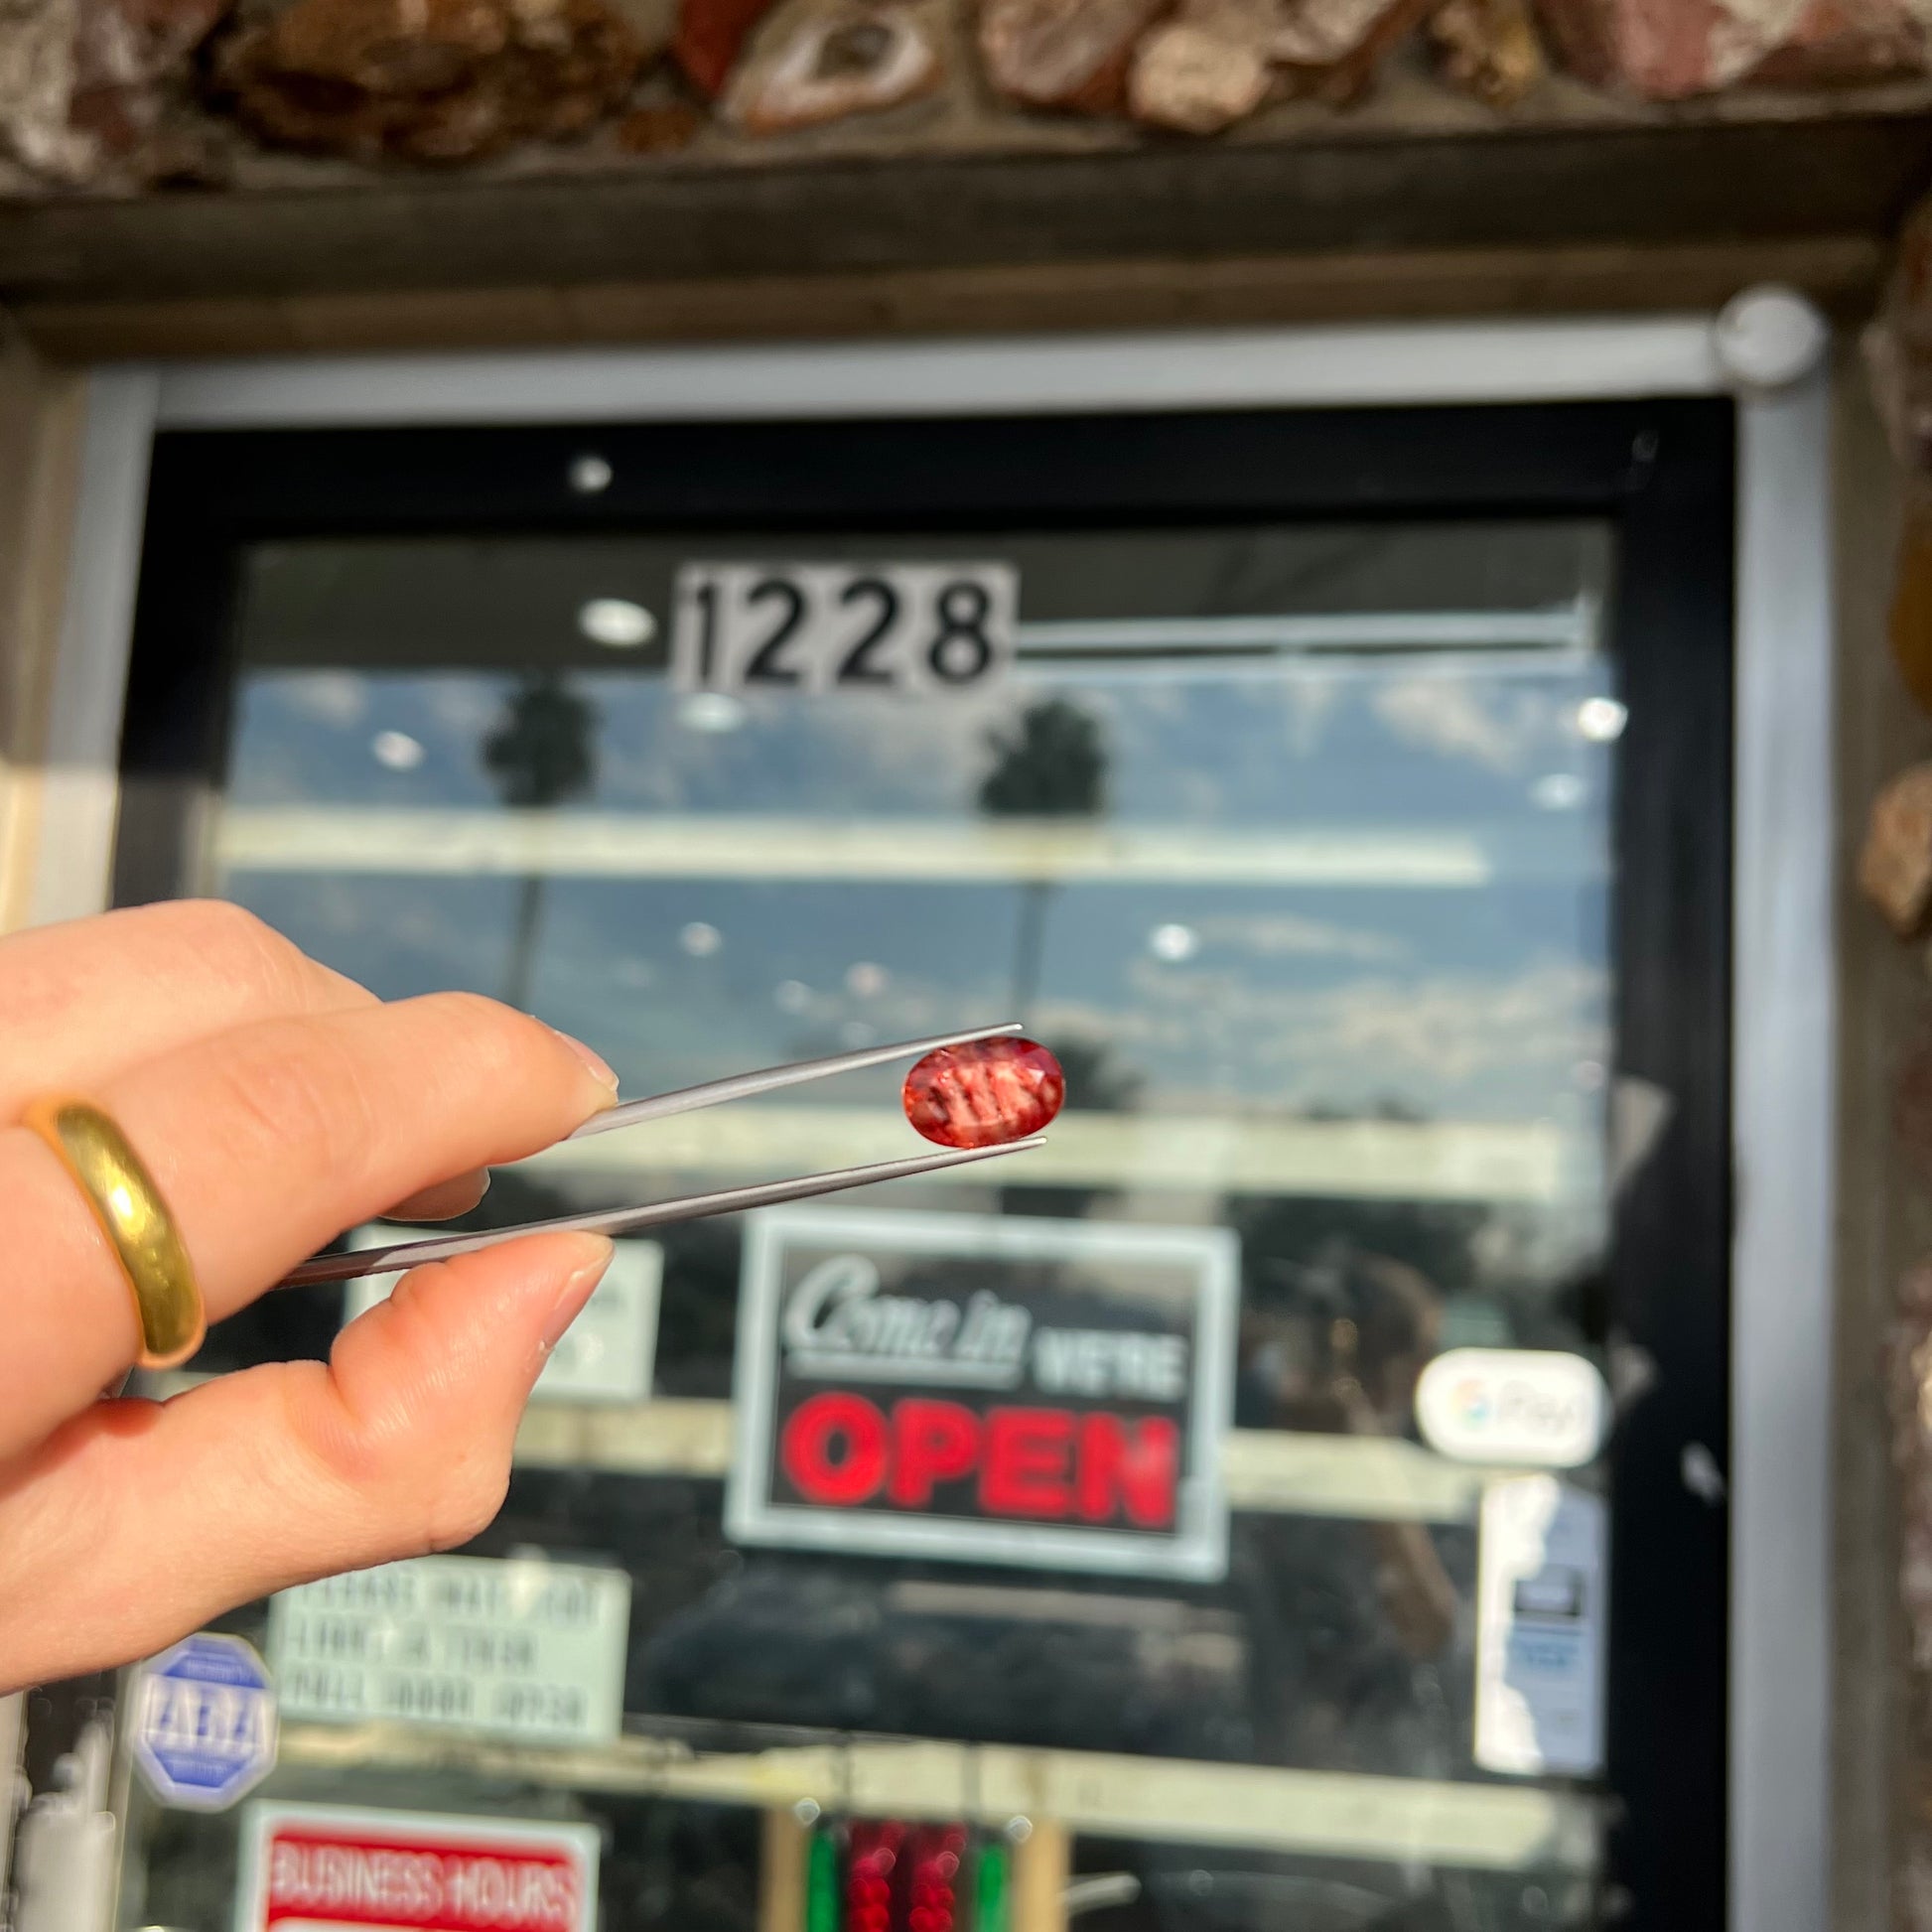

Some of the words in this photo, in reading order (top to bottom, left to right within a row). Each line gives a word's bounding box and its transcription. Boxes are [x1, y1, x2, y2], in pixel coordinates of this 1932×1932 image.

[690, 577, 994, 687] 1228
[784, 1253, 961, 1356] Come
[955, 1289, 1034, 1364] in
[1034, 1326, 1189, 1401] WE'RE
[782, 1392, 1180, 1529] OPEN
[270, 1840, 446, 1912] BUSINESS
[447, 1855, 581, 1929] HOURS
